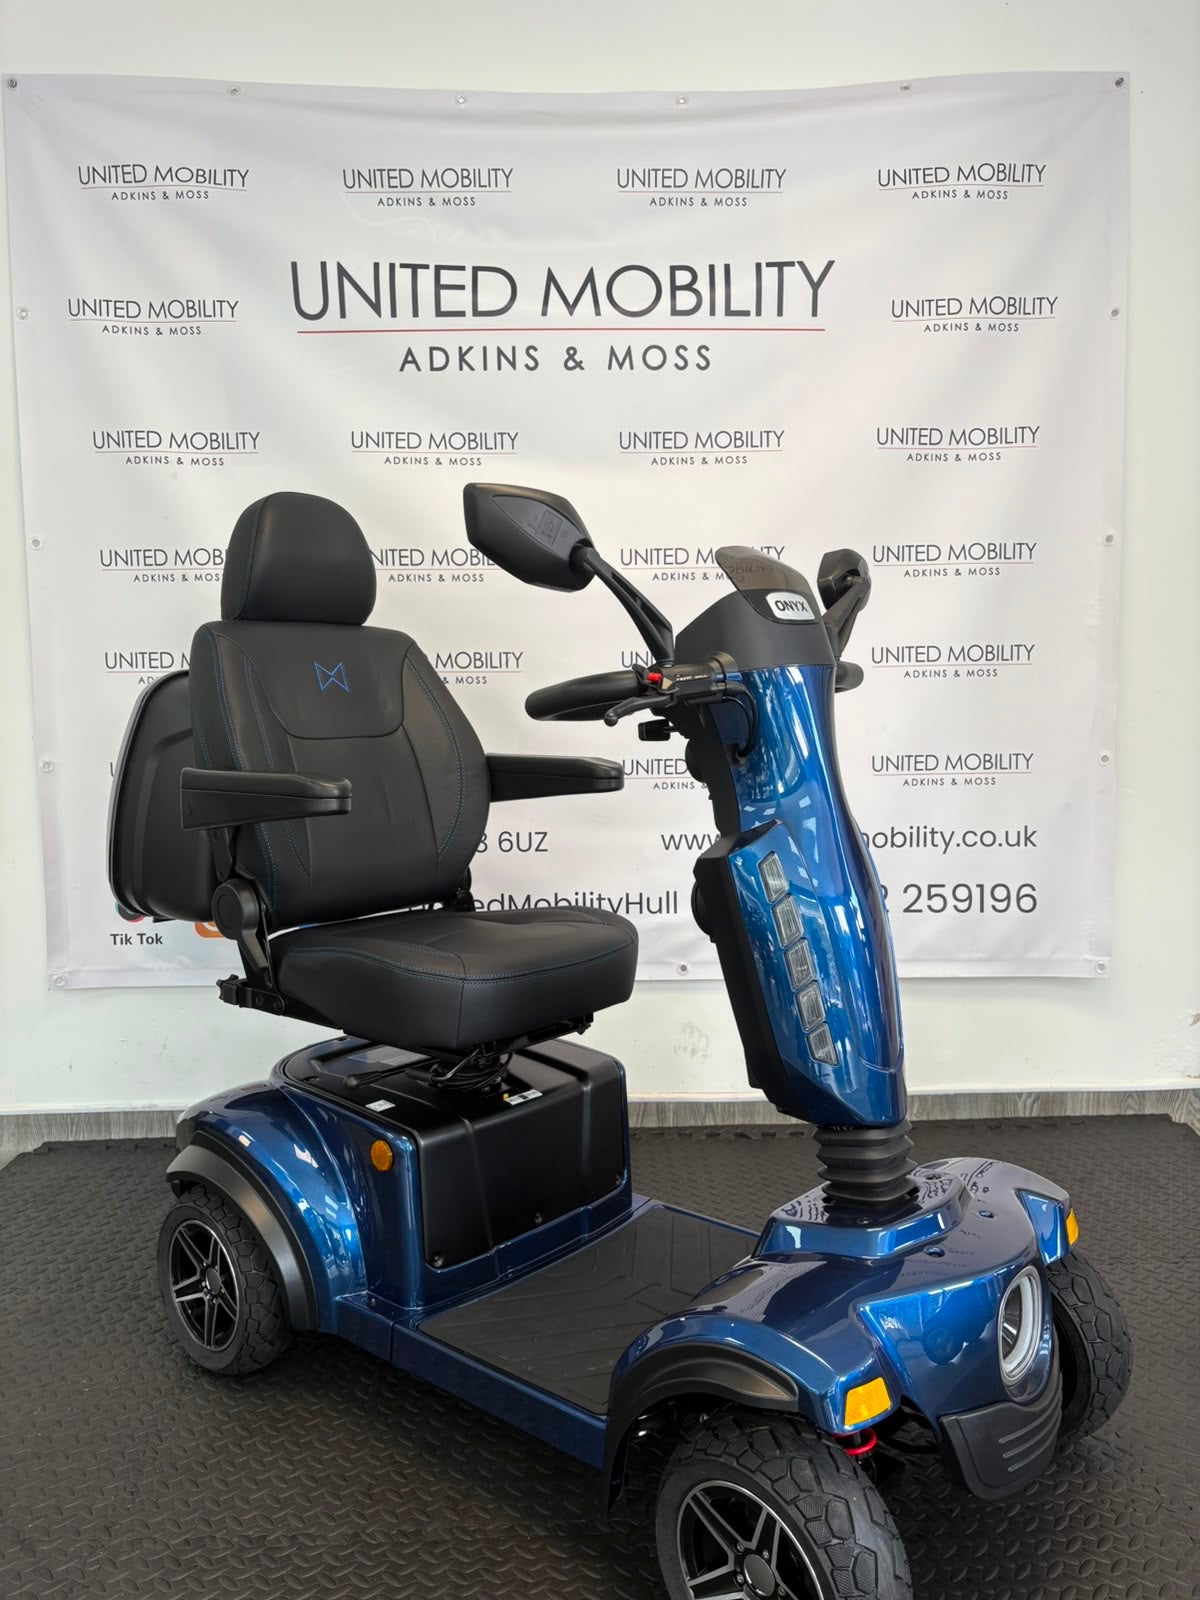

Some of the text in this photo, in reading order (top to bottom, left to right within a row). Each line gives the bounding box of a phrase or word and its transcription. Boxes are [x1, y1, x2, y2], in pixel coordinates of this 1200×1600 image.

[78, 164, 249, 187] UNITED MOBILITY
[343, 168, 513, 190] UNITED MOBILITY
[617, 168, 787, 189] UNITED MOBILITY
[878, 163, 1046, 188] UNITED MOBILITY
[112, 190, 209, 200] ADKINS & MOSS
[377, 196, 475, 207] ADKINS & MOSS
[650, 197, 747, 207] ADKINS & MOSS
[912, 189, 1008, 200] ADKINS & MOSS
[291, 260, 836, 321] UNITED MOBILITY
[68, 298, 239, 319] UNITED MOBILITY
[891, 296, 1058, 318] UNITED MOBILITY
[102, 325, 201, 336] ADKINS & MOSS
[924, 321, 1019, 333] ADKINS & MOSS
[399, 344, 711, 372] ADKINS & MOSS
[93, 430, 260, 451] UNITED MOBILITY
[351, 431, 518, 451] UNITED MOBILITY
[618, 430, 784, 450] UNITED MOBILITY
[877, 426, 1040, 446] UNITED MOBILITY
[126, 456, 224, 466] ADKINS & MOSS
[384, 456, 481, 466] ADKINS & MOSS
[651, 456, 747, 465] ADKINS & MOSS
[907, 452, 1001, 462] ADKINS & MOSS
[100, 549, 168, 567] UNITED
[371, 548, 496, 566] NITED MOBIL
[620, 547, 690, 566] UNITED
[872, 542, 1037, 563] UNITED MOBILITY
[134, 573, 220, 582] ADKINS & MOS
[388, 573, 484, 582] ADKINS & MOSS
[652, 572, 695, 581] ADKINS
[702, 572, 709, 580] &
[904, 567, 1000, 577] ADKINS & MOSS
[774, 600, 808, 612] ONYX
[105, 651, 174, 669] UNITED
[435, 651, 523, 669] MOBILITY
[621, 651, 654, 668] UNI
[872, 644, 1035, 664] UNITED MOBILITY
[443, 676, 487, 684] & MOSS
[904, 669, 997, 678] ADKINS & MOSS
[622, 759, 688, 776] UNITED
[872, 753, 1034, 773] UNITED MOBILITY
[653, 781, 695, 790] ADKINS
[903, 777, 996, 786] ADKINS & MOSS
[498, 830, 549, 853] 6UZ
[902, 883, 1037, 913] 259196
[110, 933, 163, 945] Tik Tok
